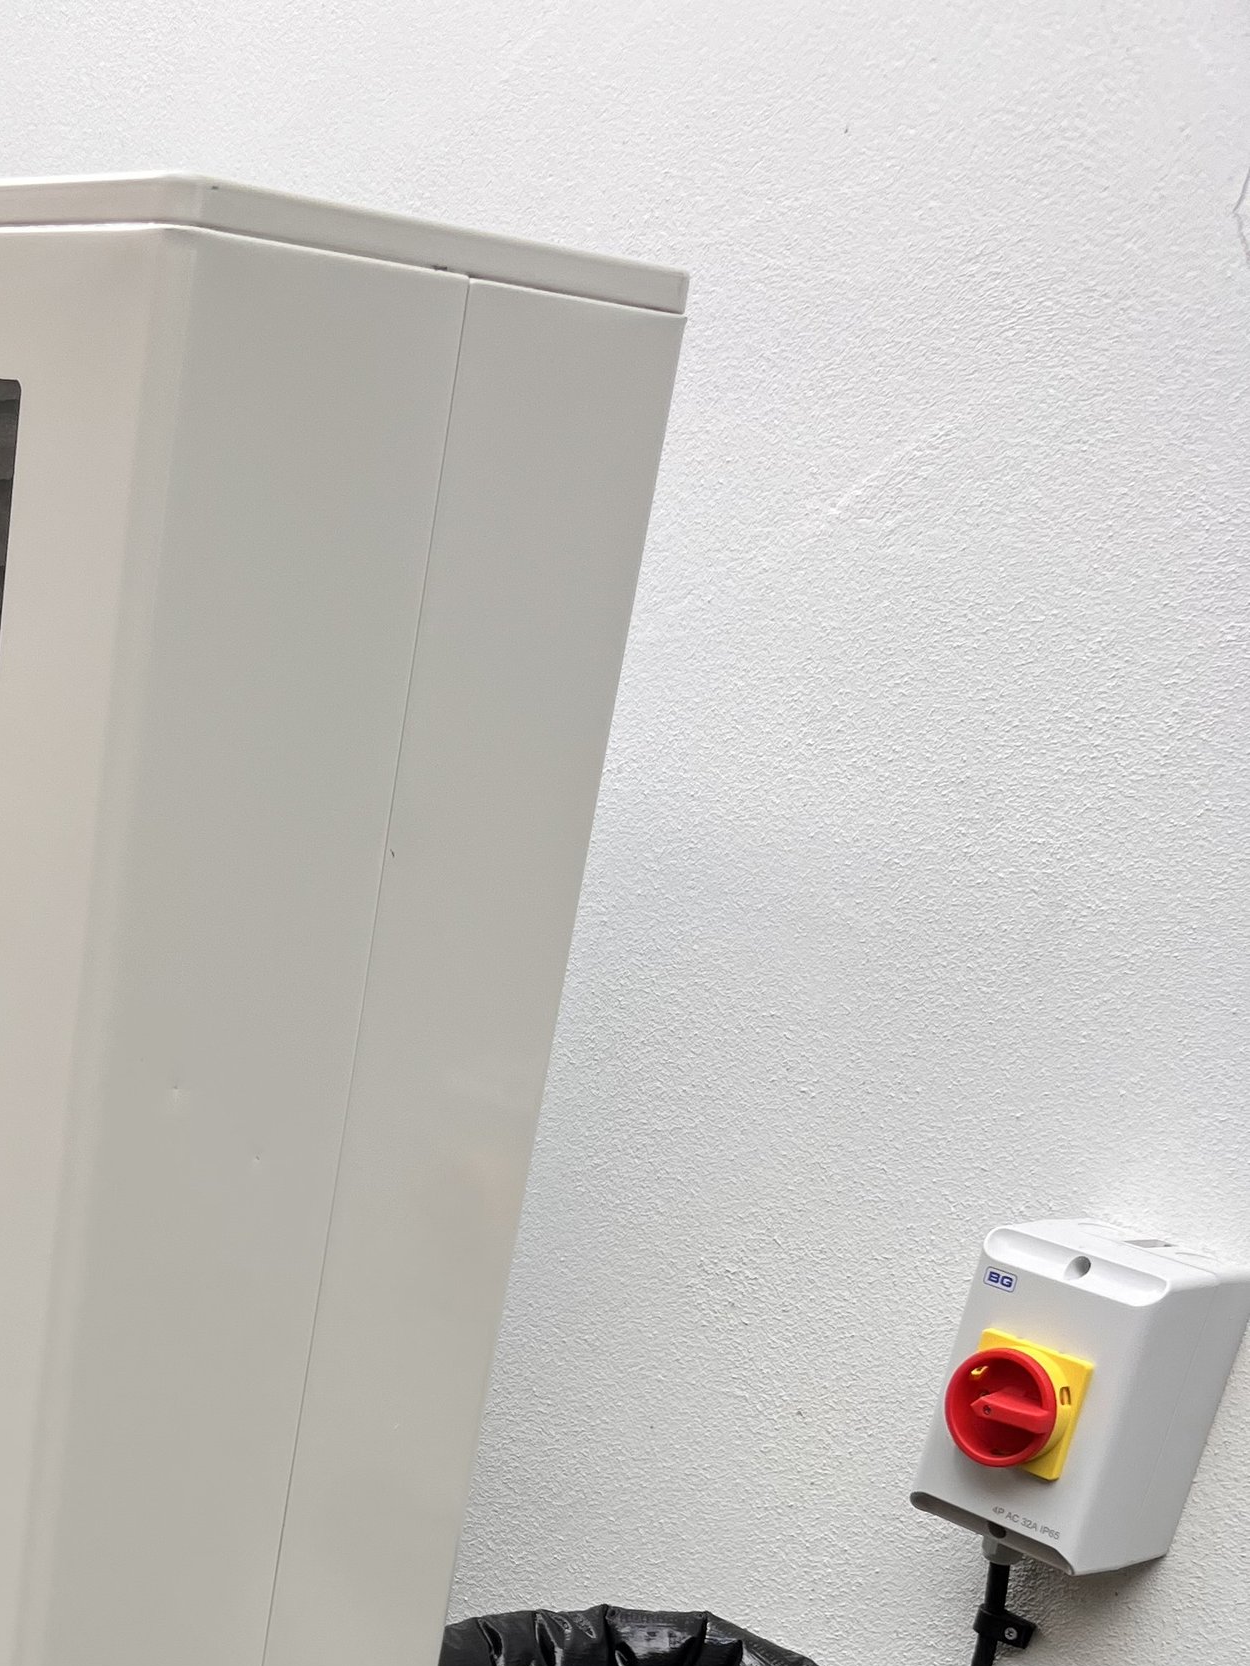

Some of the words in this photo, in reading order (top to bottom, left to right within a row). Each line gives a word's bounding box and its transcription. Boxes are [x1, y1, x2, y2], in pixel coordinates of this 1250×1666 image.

[988, 1271, 1013, 1288] BG
[1005, 1511, 1020, 1523] AC
[1020, 1517, 1038, 1532] 32A
[1039, 1525, 1060, 1540] IP65
